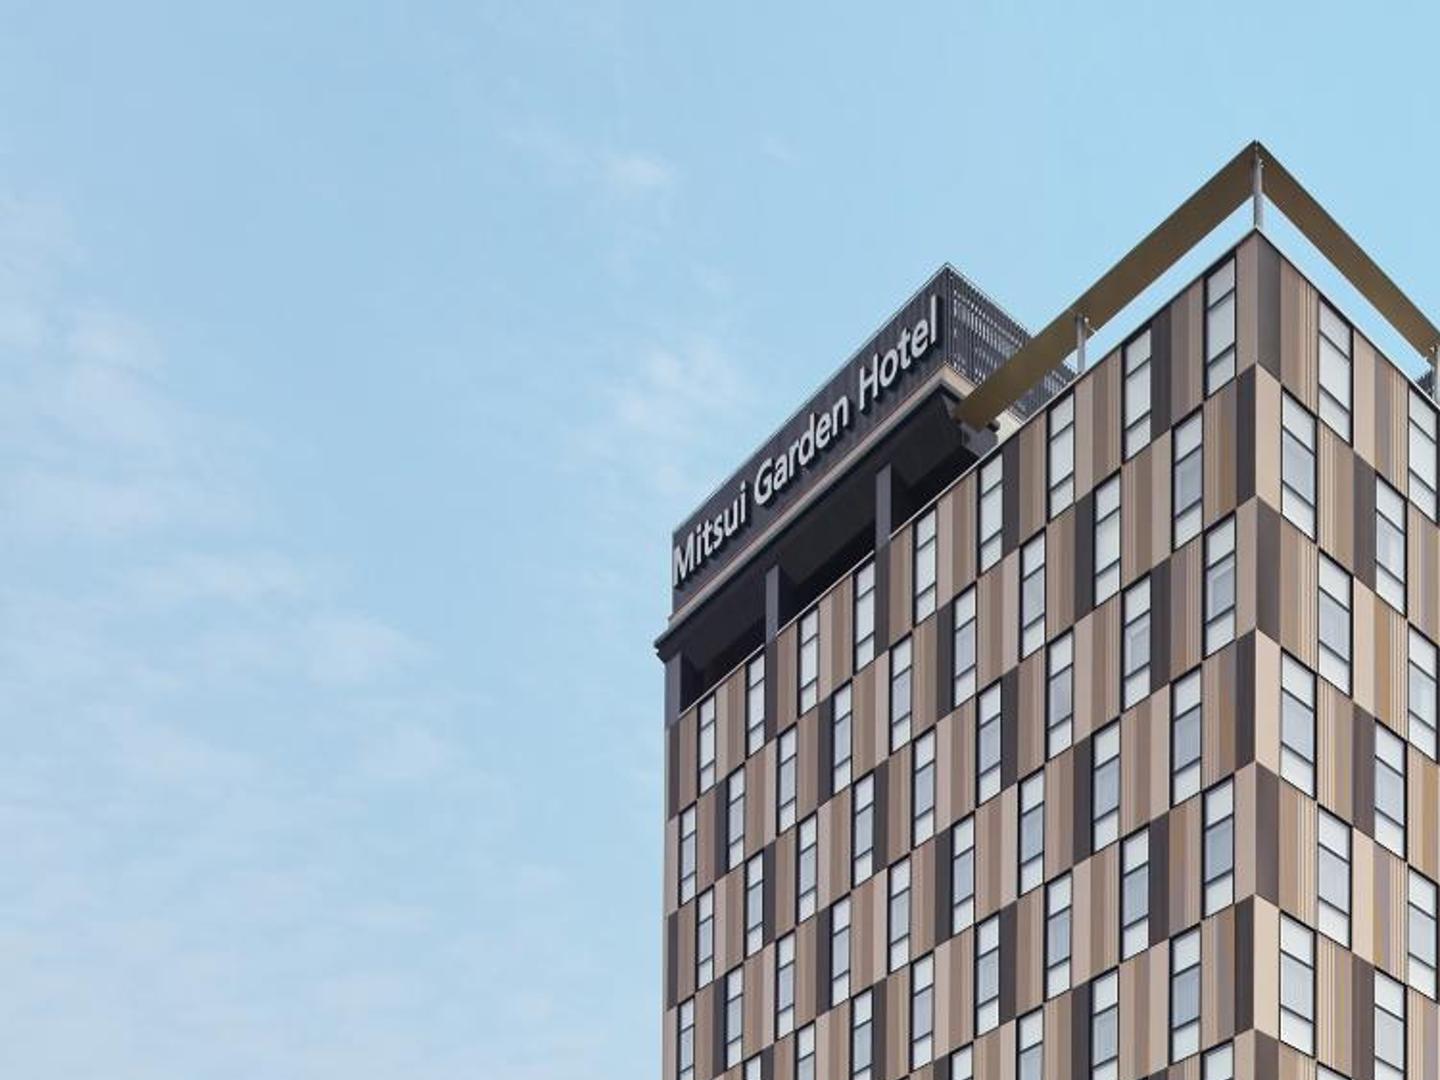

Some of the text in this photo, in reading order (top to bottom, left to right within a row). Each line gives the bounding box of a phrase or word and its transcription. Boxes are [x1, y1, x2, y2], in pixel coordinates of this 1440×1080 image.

[673, 294, 938, 586] Mitsui Garden Hotel
